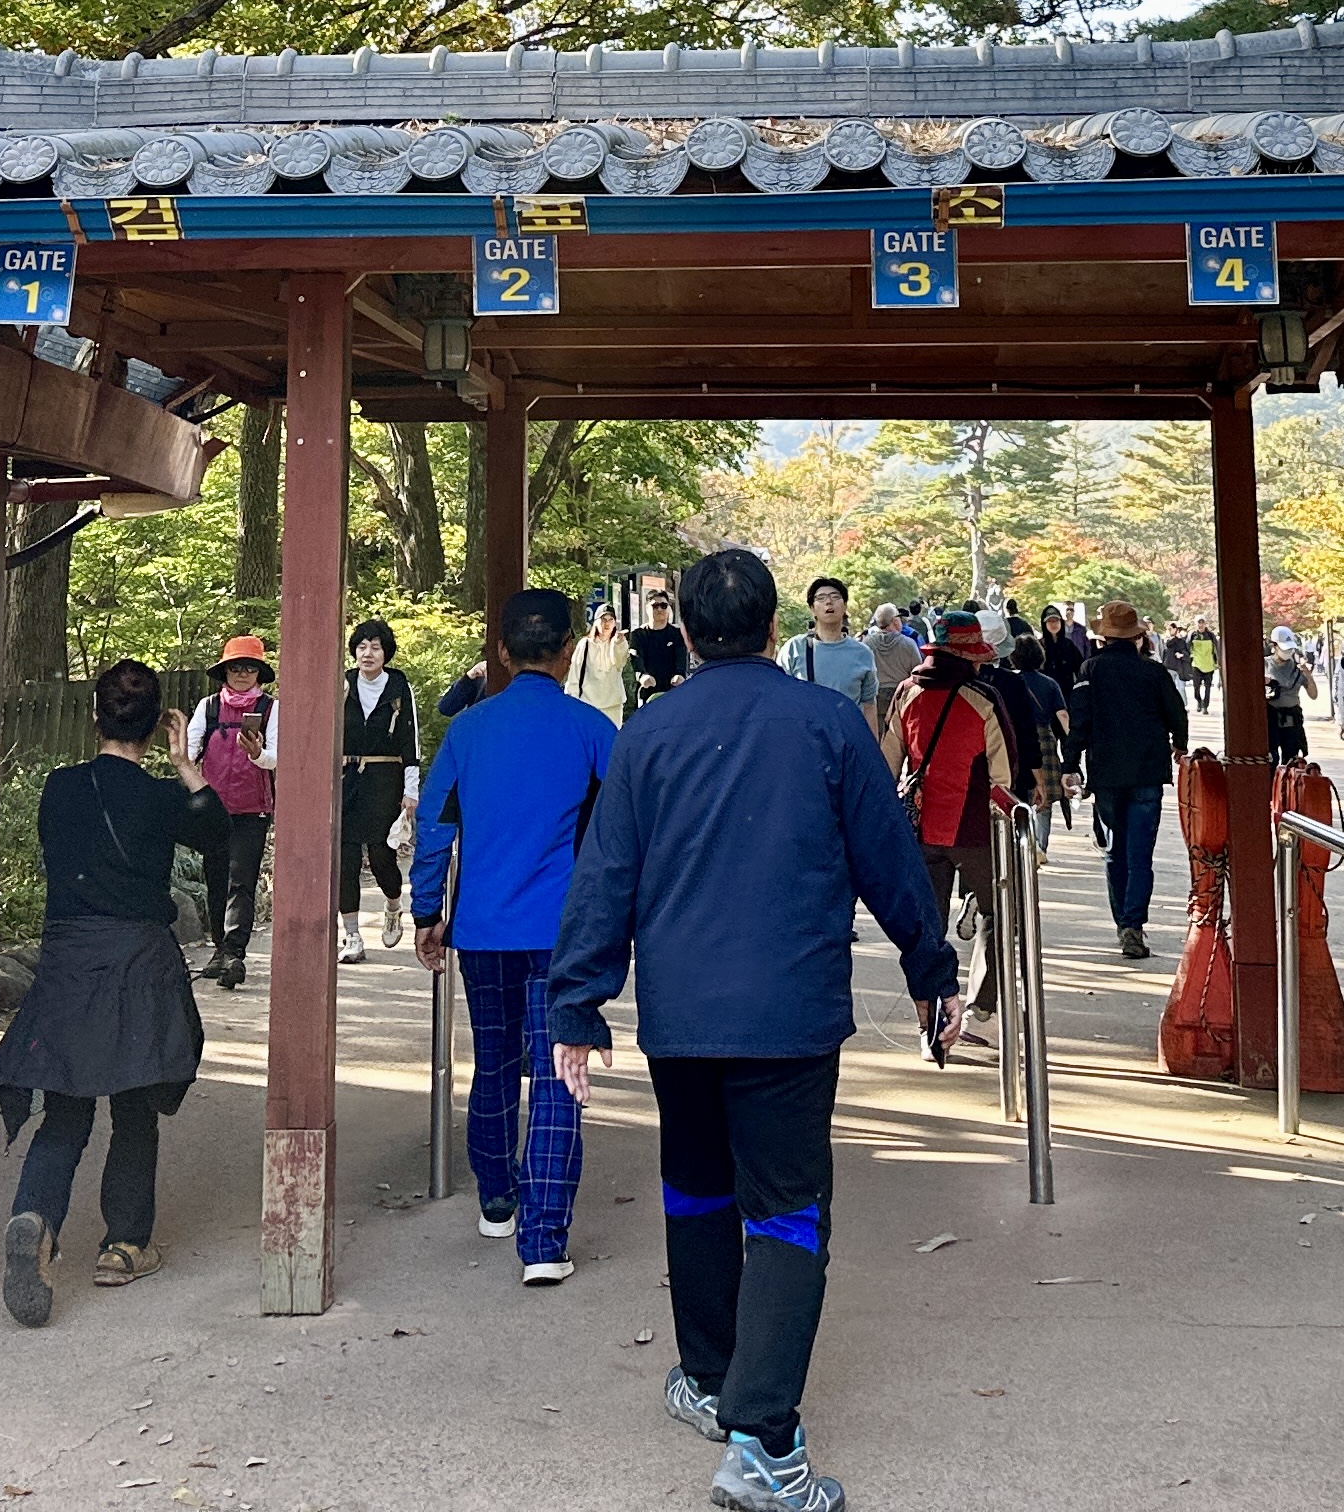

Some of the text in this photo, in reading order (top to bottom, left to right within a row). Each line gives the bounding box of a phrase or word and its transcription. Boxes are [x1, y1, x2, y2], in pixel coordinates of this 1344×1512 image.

[110, 198, 179, 241] 검
[484, 238, 546, 260] GATE
[882, 231, 946, 253] GATE
[1199, 226, 1265, 249] GATE
[4, 249, 67, 271] GATE
[1216, 258, 1250, 292] 4
[500, 267, 531, 301] 2
[898, 261, 931, 297] 3
[20, 280, 40, 314] 1
